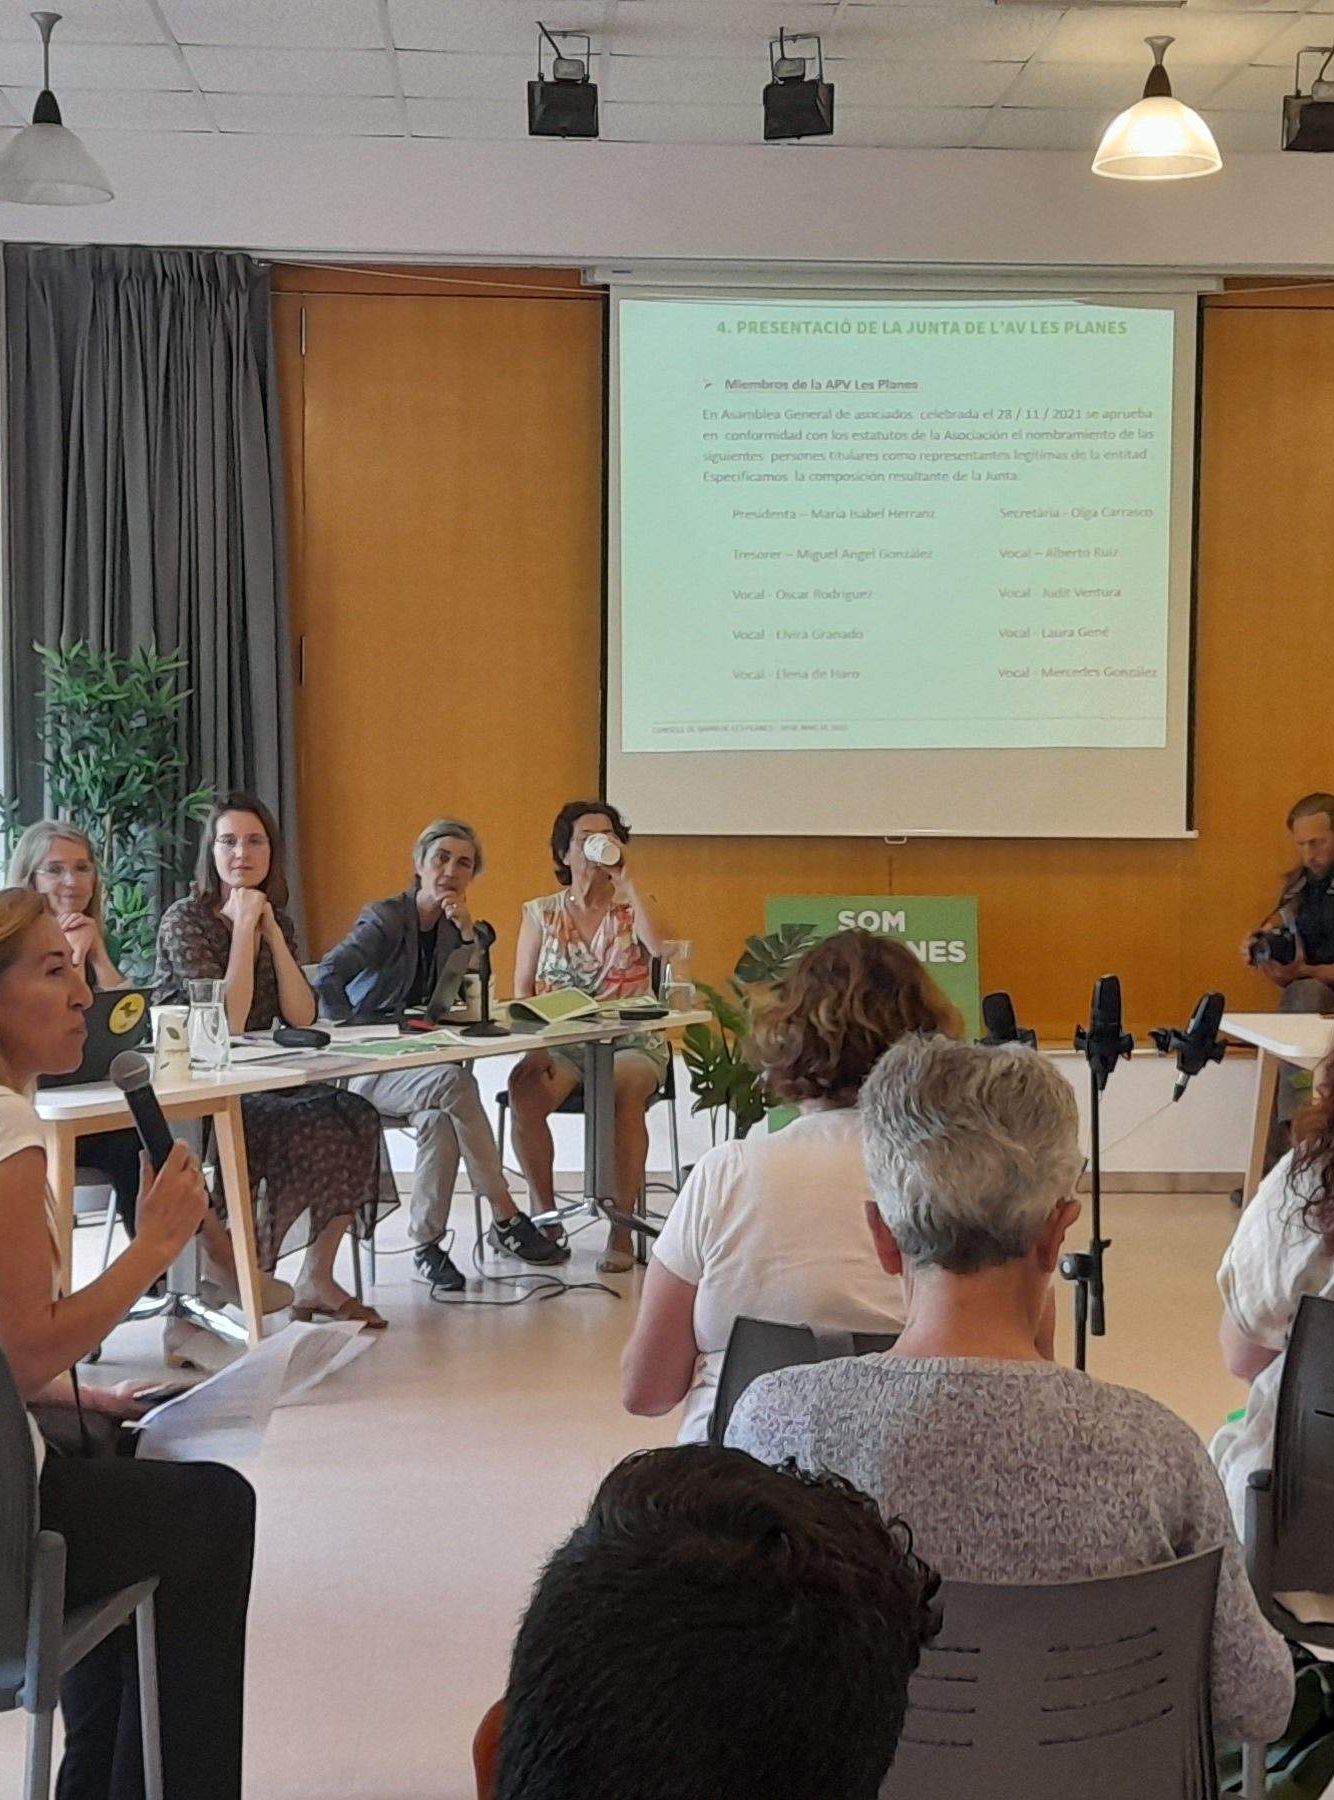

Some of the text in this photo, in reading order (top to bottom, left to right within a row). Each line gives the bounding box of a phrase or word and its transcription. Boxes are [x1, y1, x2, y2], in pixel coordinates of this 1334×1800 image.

[717, 321, 731, 335] 4.
[737, 318, 851, 335] PRESENTACIÓ
[857, 321, 877, 335] DE
[883, 321, 901, 335] LA
[906, 321, 960, 335] JUNTA
[965, 321, 986, 335] DE
[1031, 321, 1059, 335] LES
[1064, 321, 1126, 335] PLANES
[725, 378, 918, 391] Miembros de la APV Les Planes
[703, 410, 717, 420] En
[721, 409, 780, 420] Asamblea
[785, 409, 832, 420] General
[835, 409, 850, 420] de
[920, 409, 979, 420] celebrada
[983, 409, 994, 420] el
[1053, 410, 1081, 419] 2021
[1086, 411, 1098, 419] se
[1102, 410, 1152, 421] aprueba
[703, 432, 717, 440] en
[725, 430, 802, 441] conformidad
[805, 432, 827, 440] con
[831, 430, 847, 441] los
[851, 430, 907, 441] estatutos
[911, 430, 925, 441] de
[930, 430, 940, 441] la
[1011, 430, 1022, 441] el
[1026, 430, 1116, 441] nombramiento
[1119, 430, 1134, 441] de
[1138, 430, 1154, 441] las
[703, 451, 763, 464] siguientes
[829, 451, 878, 461] titulares
[882, 453, 917, 461] como
[920, 451, 1010, 462] representantes
[1071, 449, 1085, 460] de
[1091, 449, 1100, 460] la
[703, 471, 788, 483] Especificamos
[795, 471, 805, 481] la
[889, 471, 949, 481] resultante
[952, 471, 968, 481] de
[972, 471, 982, 481] la
[732, 509, 796, 519] Presidenta
[850, 509, 884, 519] Isabel
[1071, 508, 1098, 520] Olga
[1102, 507, 1153, 517] Carrasco
[733, 550, 782, 559] Tresorer
[797, 549, 838, 562] Miguel
[1000, 548, 1030, 558] Vocal
[1046, 547, 1090, 557] Alberto
[1094, 547, 1119, 557] Ruiz
[732, 590, 764, 600] Vocal
[999, 589, 1030, 598] Vocal
[1075, 589, 1121, 598] Ventura
[733, 630, 765, 640] Vocal
[777, 630, 808, 640] Elvira
[812, 630, 864, 640] Granado
[999, 628, 1030, 638] Vocal
[1042, 628, 1074, 638] Laura
[733, 670, 765, 680] Vocal
[812, 669, 827, 679] de
[999, 668, 1029, 678] Vocal
[1041, 668, 1099, 678] Mercedes
[837, 910, 905, 932] SOM
[906, 941, 967, 962] NES
